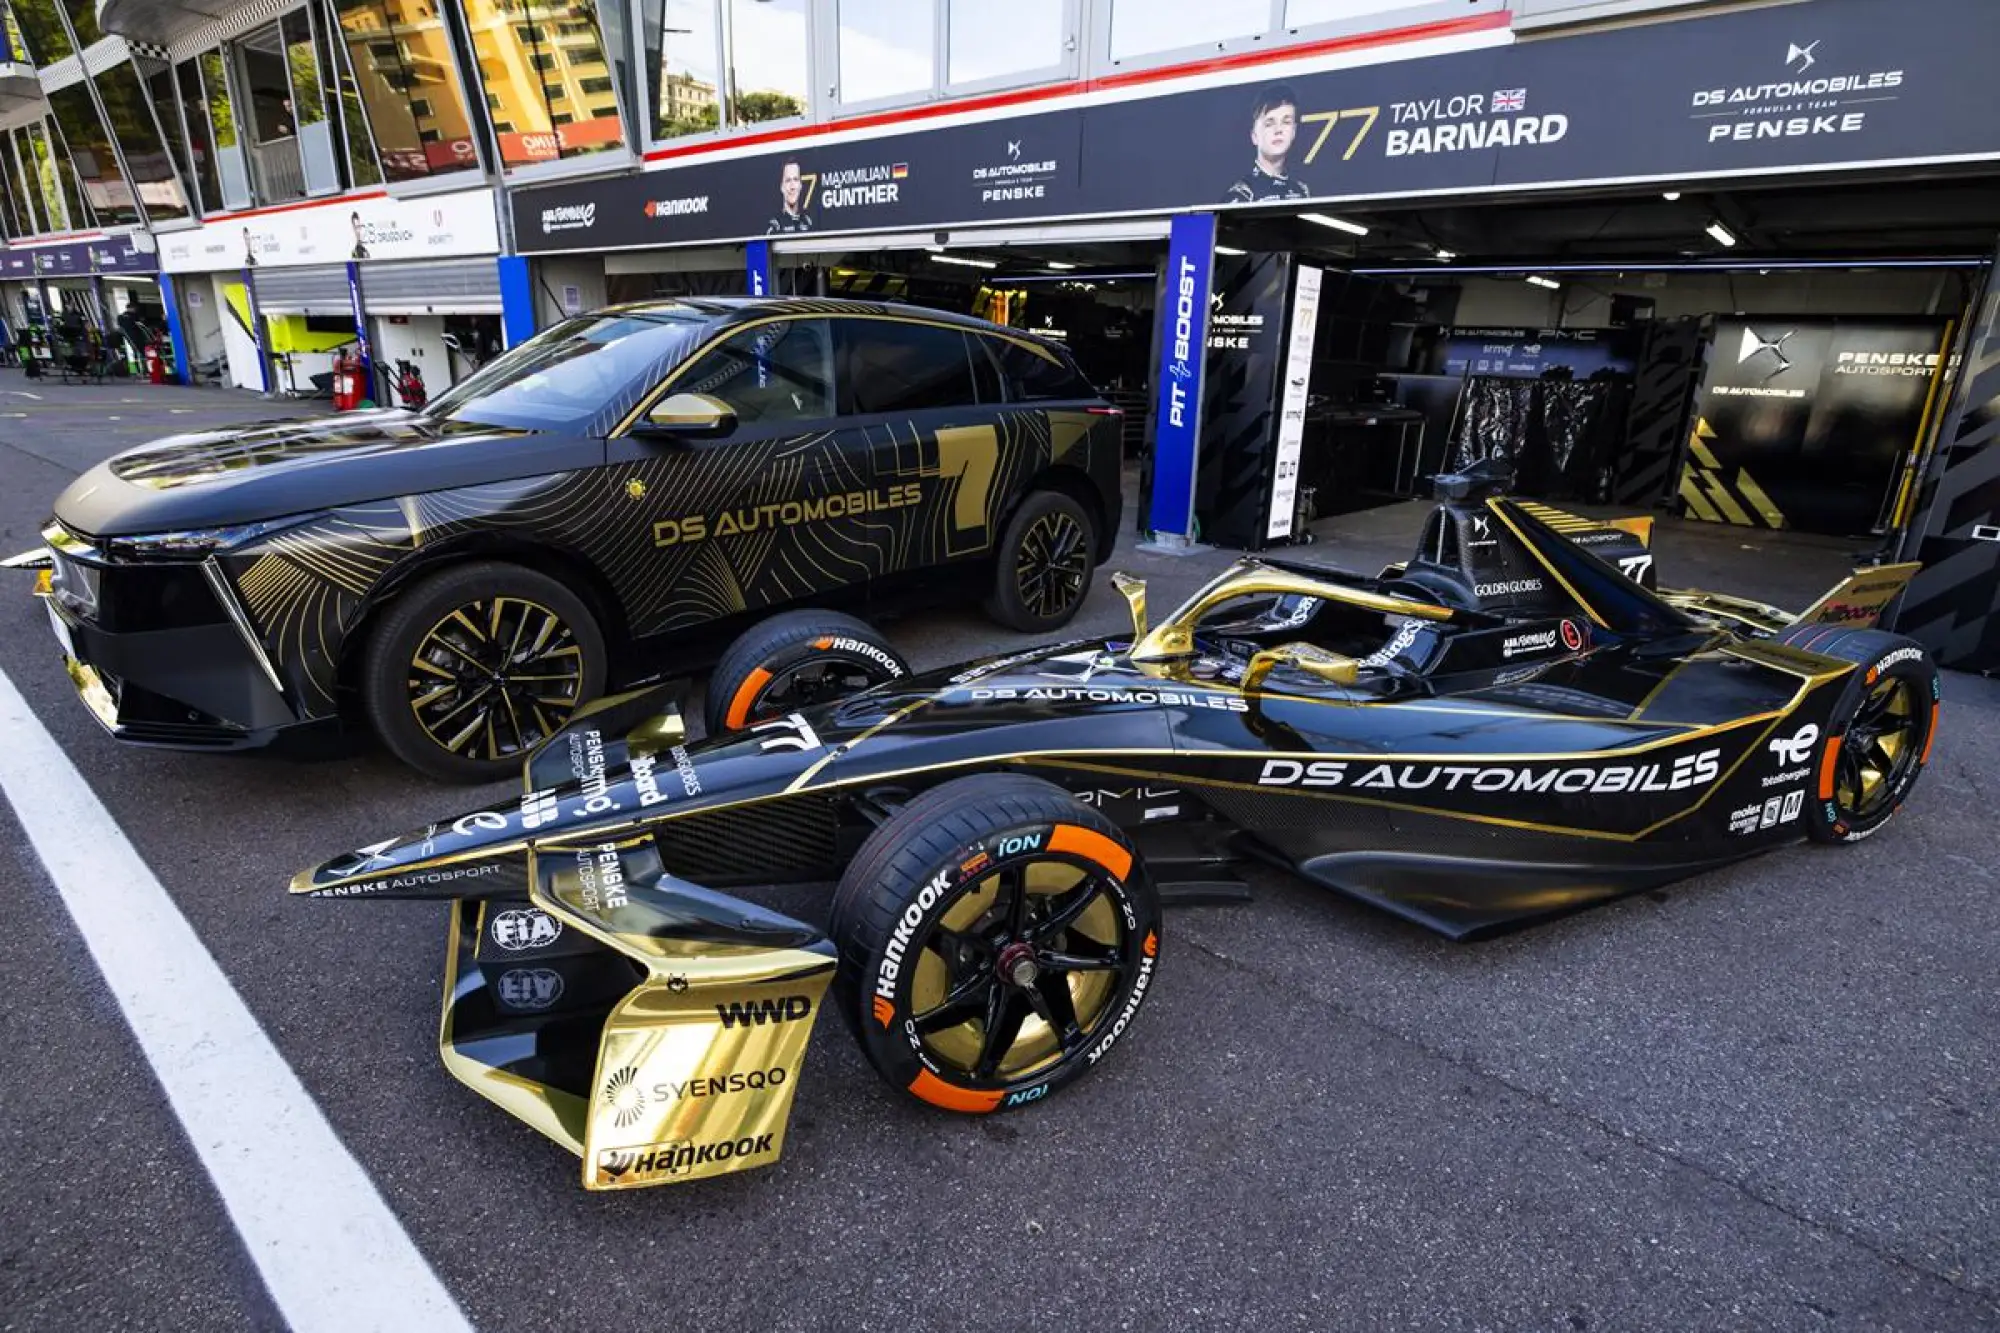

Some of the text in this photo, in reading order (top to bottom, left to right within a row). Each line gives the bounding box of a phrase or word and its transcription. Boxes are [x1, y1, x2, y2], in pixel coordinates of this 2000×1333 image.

[1692, 70, 1903, 106] DS AUTOMOBILES
[1390, 94, 1484, 124] TAYLOR
[1743, 104, 1792, 115] FORMULA
[1808, 100, 1838, 110] TEAM
[1301, 106, 1380, 164] 77
[1385, 114, 1568, 157] BARNARD
[1708, 113, 1865, 142] PENSKE
[821, 165, 891, 187] MAXIMILIAN
[988, 160, 1056, 178] AUTOMOBILES
[800, 173, 817, 209] 7
[821, 183, 899, 209] GÜNTHER
[983, 185, 1045, 202] PENSKE
[1170, 255, 1196, 428] PIT BOOST
[934, 424, 999, 531] 7
[654, 483, 922, 548] DS AUTOMOBILES
[1474, 578, 1543, 597] GOLDEN GLOBES
[1619, 555, 1653, 585] 77
[971, 686, 1249, 713] DS AUTOMOBILES
[1257, 748, 1721, 794] DS AUTOMOBILES
[309, 864, 501, 898] PENSKE AUTOSPORT
[576, 849, 601, 911] UTOSPORT
[598, 842, 628, 909] PENSKE
[715, 994, 812, 1029] WWD
[653, 1066, 787, 1104] SYENSQO
